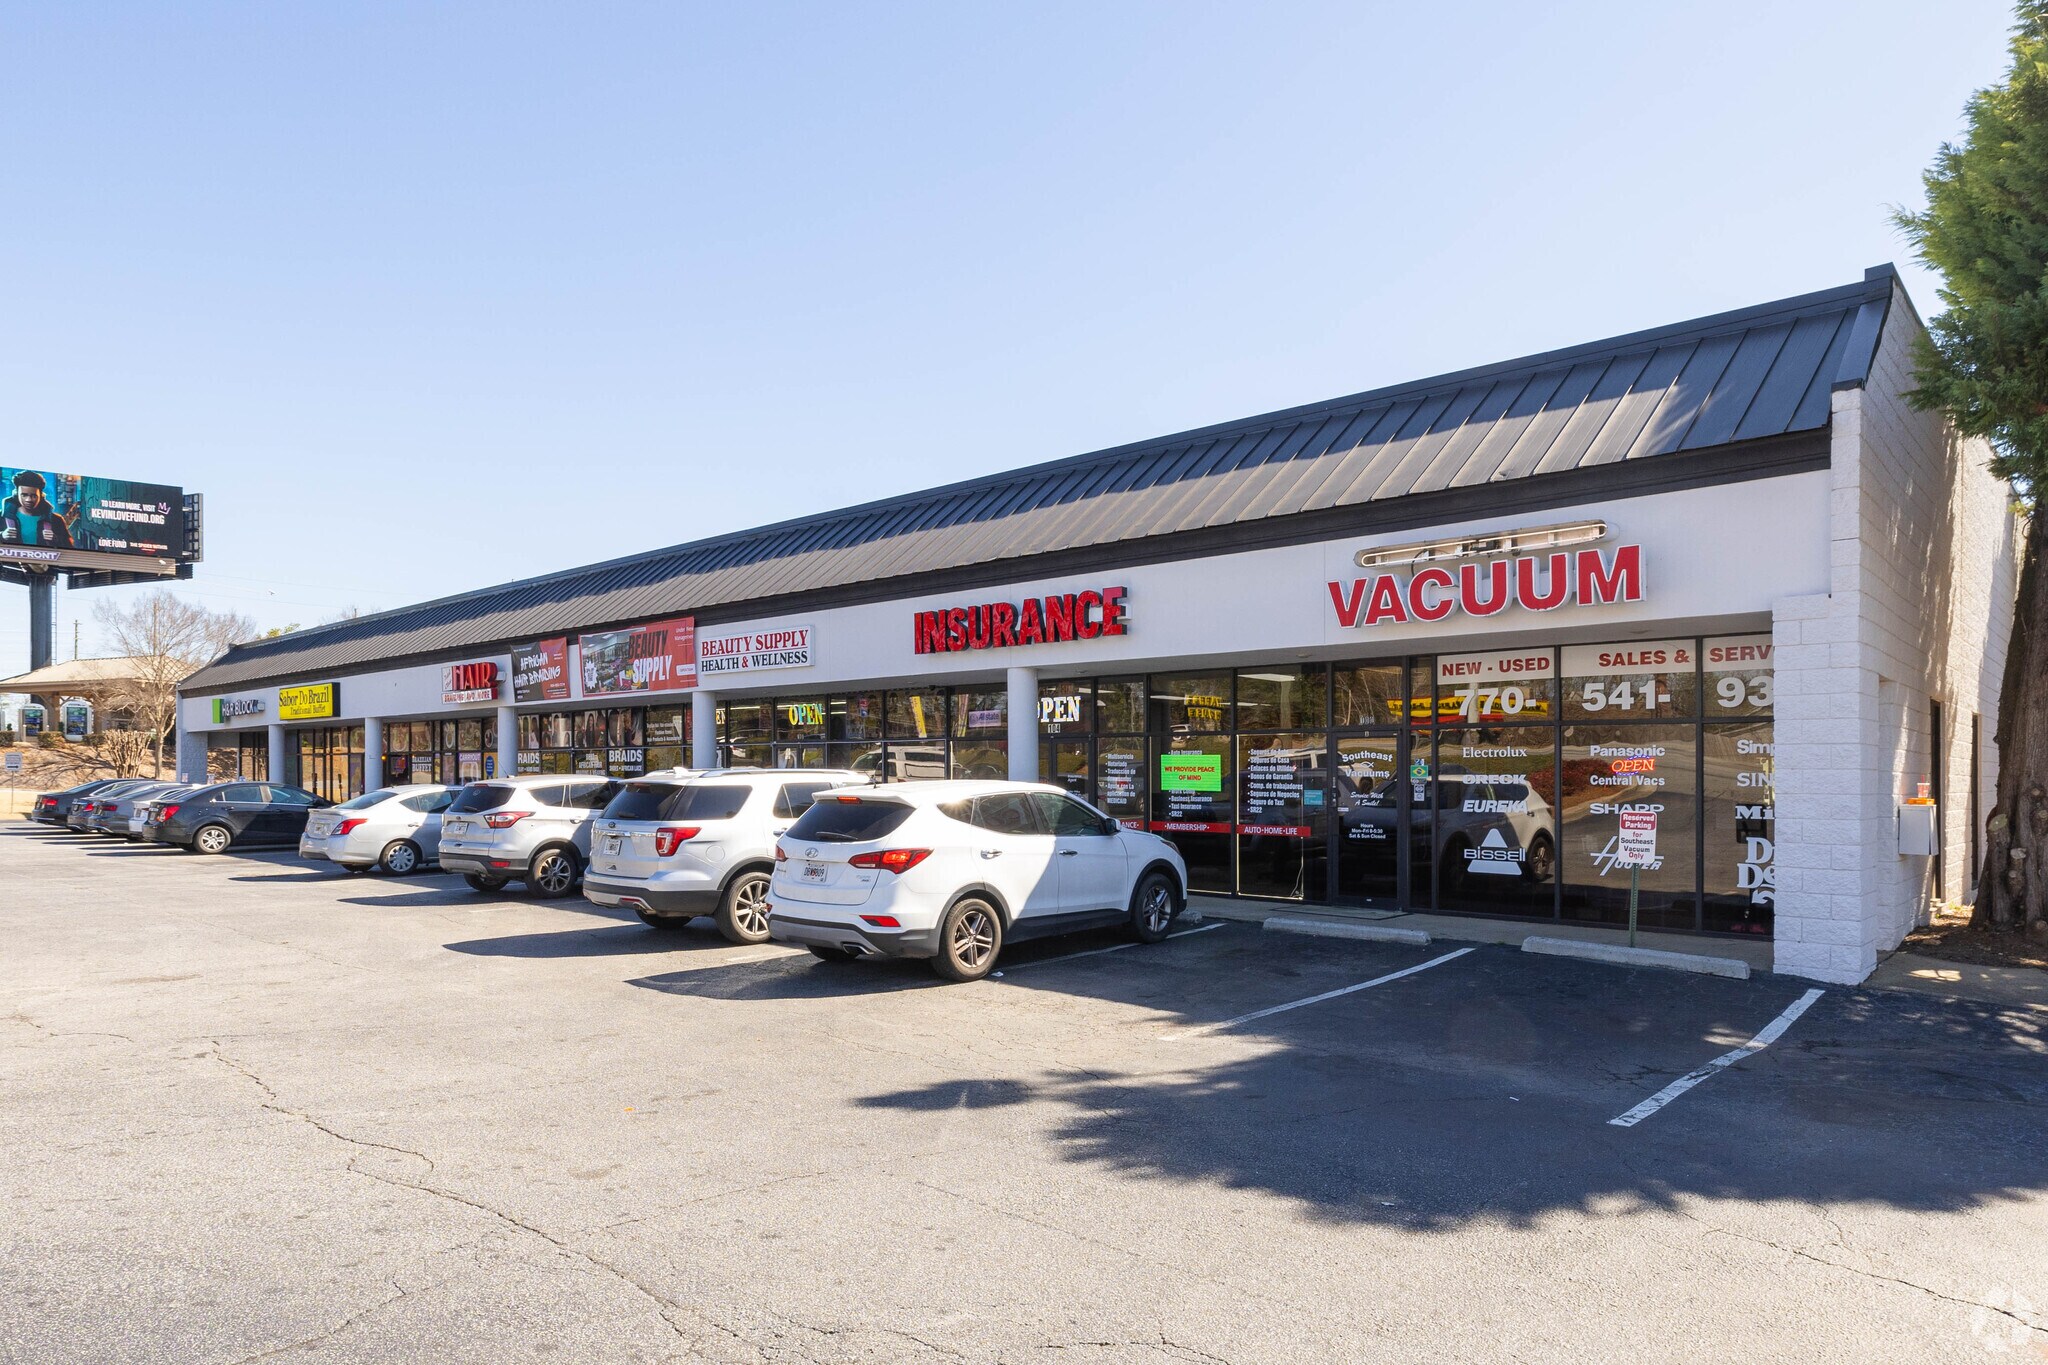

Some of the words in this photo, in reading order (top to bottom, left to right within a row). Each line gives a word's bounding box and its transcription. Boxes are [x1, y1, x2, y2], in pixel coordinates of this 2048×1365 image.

[109, 501, 125, 509] LEARN
[142, 504, 156, 512] VISIT
[91, 508, 165, 525] KEVINLOVEFUND.ORG
[0, 548, 57, 560] OUTFRONT
[1328, 544, 1644, 628] VACUUM
[914, 586, 1127, 655] INSURANCE
[629, 629, 669, 658] BEAUTY
[702, 636, 752, 656] BEAUTY
[755, 630, 808, 651] SUPPLY
[521, 652, 548, 671] AFRICAN
[701, 657, 739, 672] HEALTH
[741, 656, 748, 668] &
[751, 650, 808, 667] WELLNESS
[1442, 661, 1482, 676] NEW
[1499, 657, 1550, 673] USED
[1598, 650, 1666, 667] SALES
[1674, 649, 1689, 663] &
[452, 662, 495, 690] HAIR
[633, 655, 672, 683] SUPPLY
[279, 692, 298, 707] Sabor
[299, 690, 307, 704] Do
[308, 686, 329, 703] Brazil
[1454, 686, 1537, 716] 770-
[1581, 680, 1671, 712] 541-
[222, 702, 235, 717] H&R
[235, 700, 254, 715] BLOCK
[290, 706, 311, 715] Traditional
[312, 705, 326, 714] Buffet
[788, 703, 823, 725] OPEN
[1037, 696, 1081, 722] PEN
[608, 749, 642, 762] BRAIDS
[1342, 750, 1393, 762] Southeast
[1462, 746, 1527, 758] Electrolux
[1590, 745, 1665, 757] Panasonic
[1345, 769, 1391, 778] Vacuums
[1611, 758, 1654, 773] OPEN
[1462, 774, 1527, 785] ORECK
[1590, 775, 1632, 786] Central
[1636, 775, 1665, 786] Vacs
[1462, 800, 1528, 813] EUREKA
[1166, 823, 1207, 831] MEMBERSHIP
[1590, 836, 1664, 876] HOOER
[1628, 852, 1644, 860] Only
